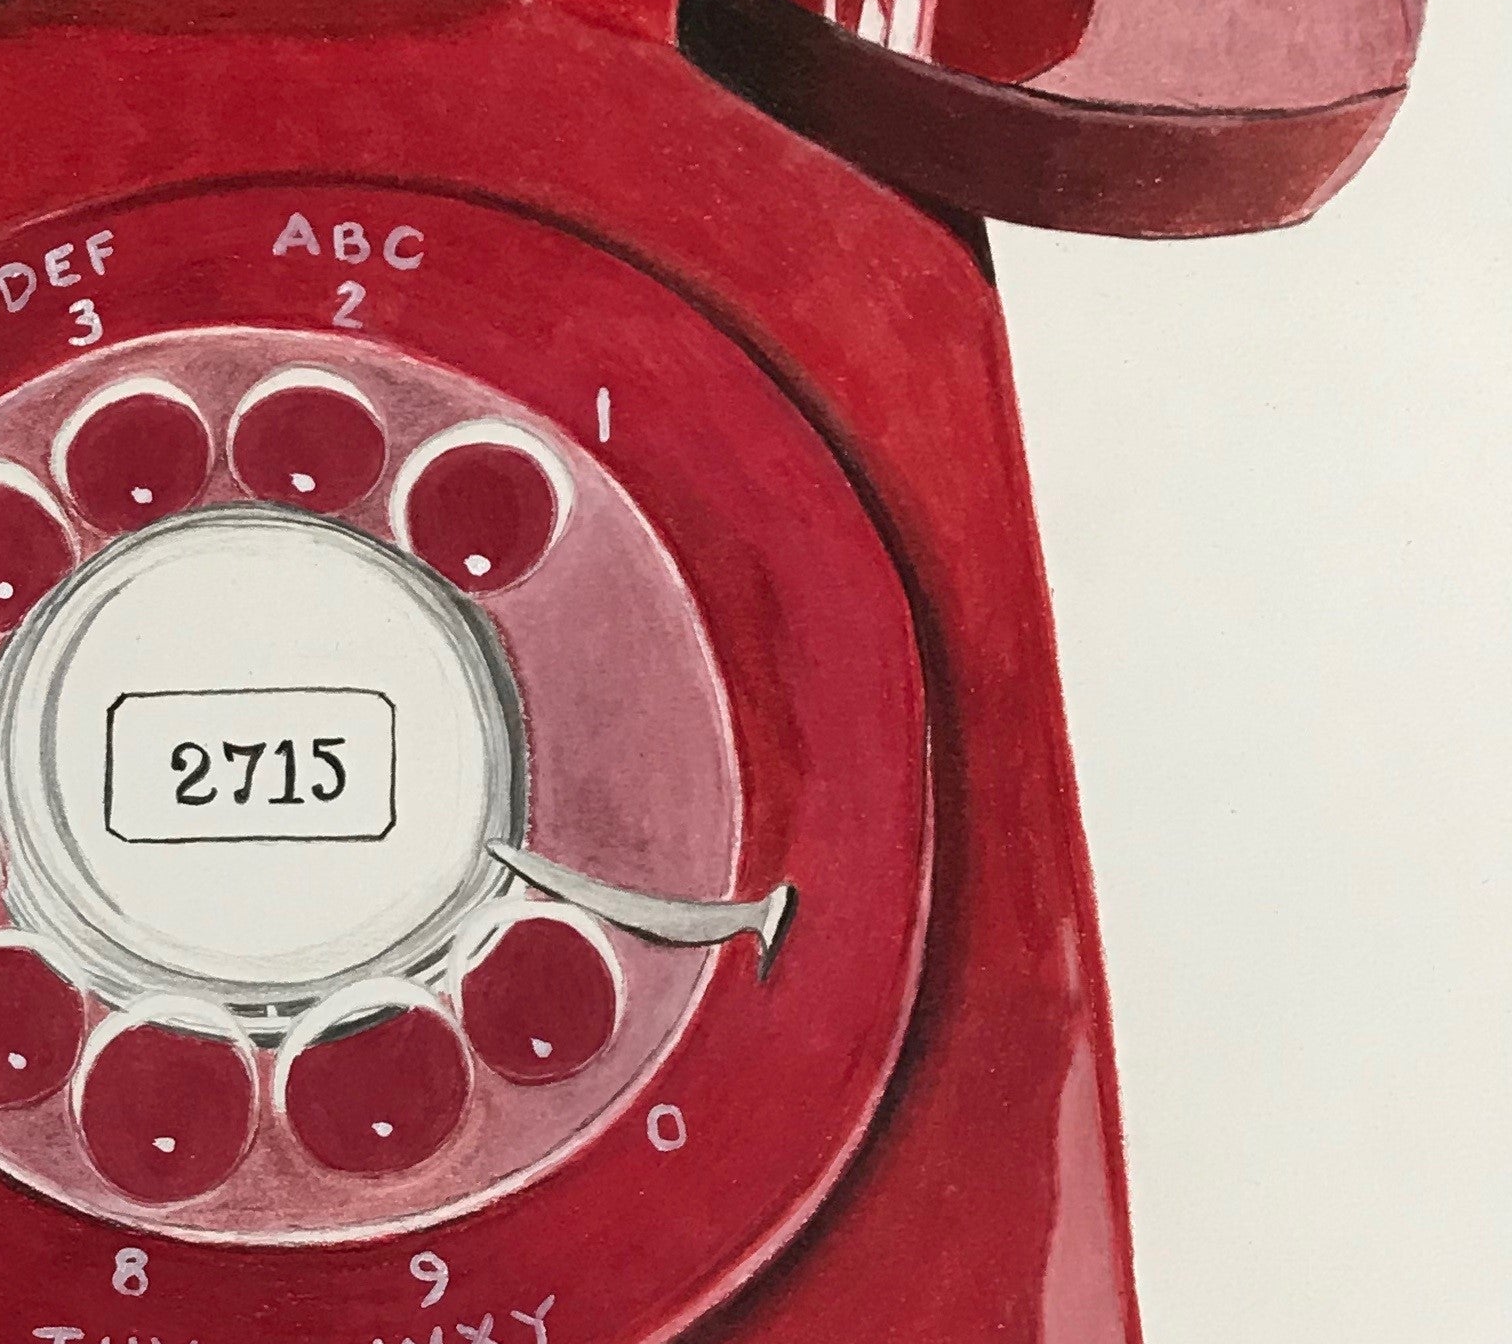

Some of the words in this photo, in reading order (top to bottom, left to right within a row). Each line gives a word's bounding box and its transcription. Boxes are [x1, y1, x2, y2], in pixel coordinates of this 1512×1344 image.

[272, 212, 425, 271] ABC
[67, 298, 104, 347] 3
[331, 280, 367, 329] 2
[170, 737, 346, 807] 2715
[111, 1247, 149, 1297] 8
[409, 1250, 450, 1309] 9
